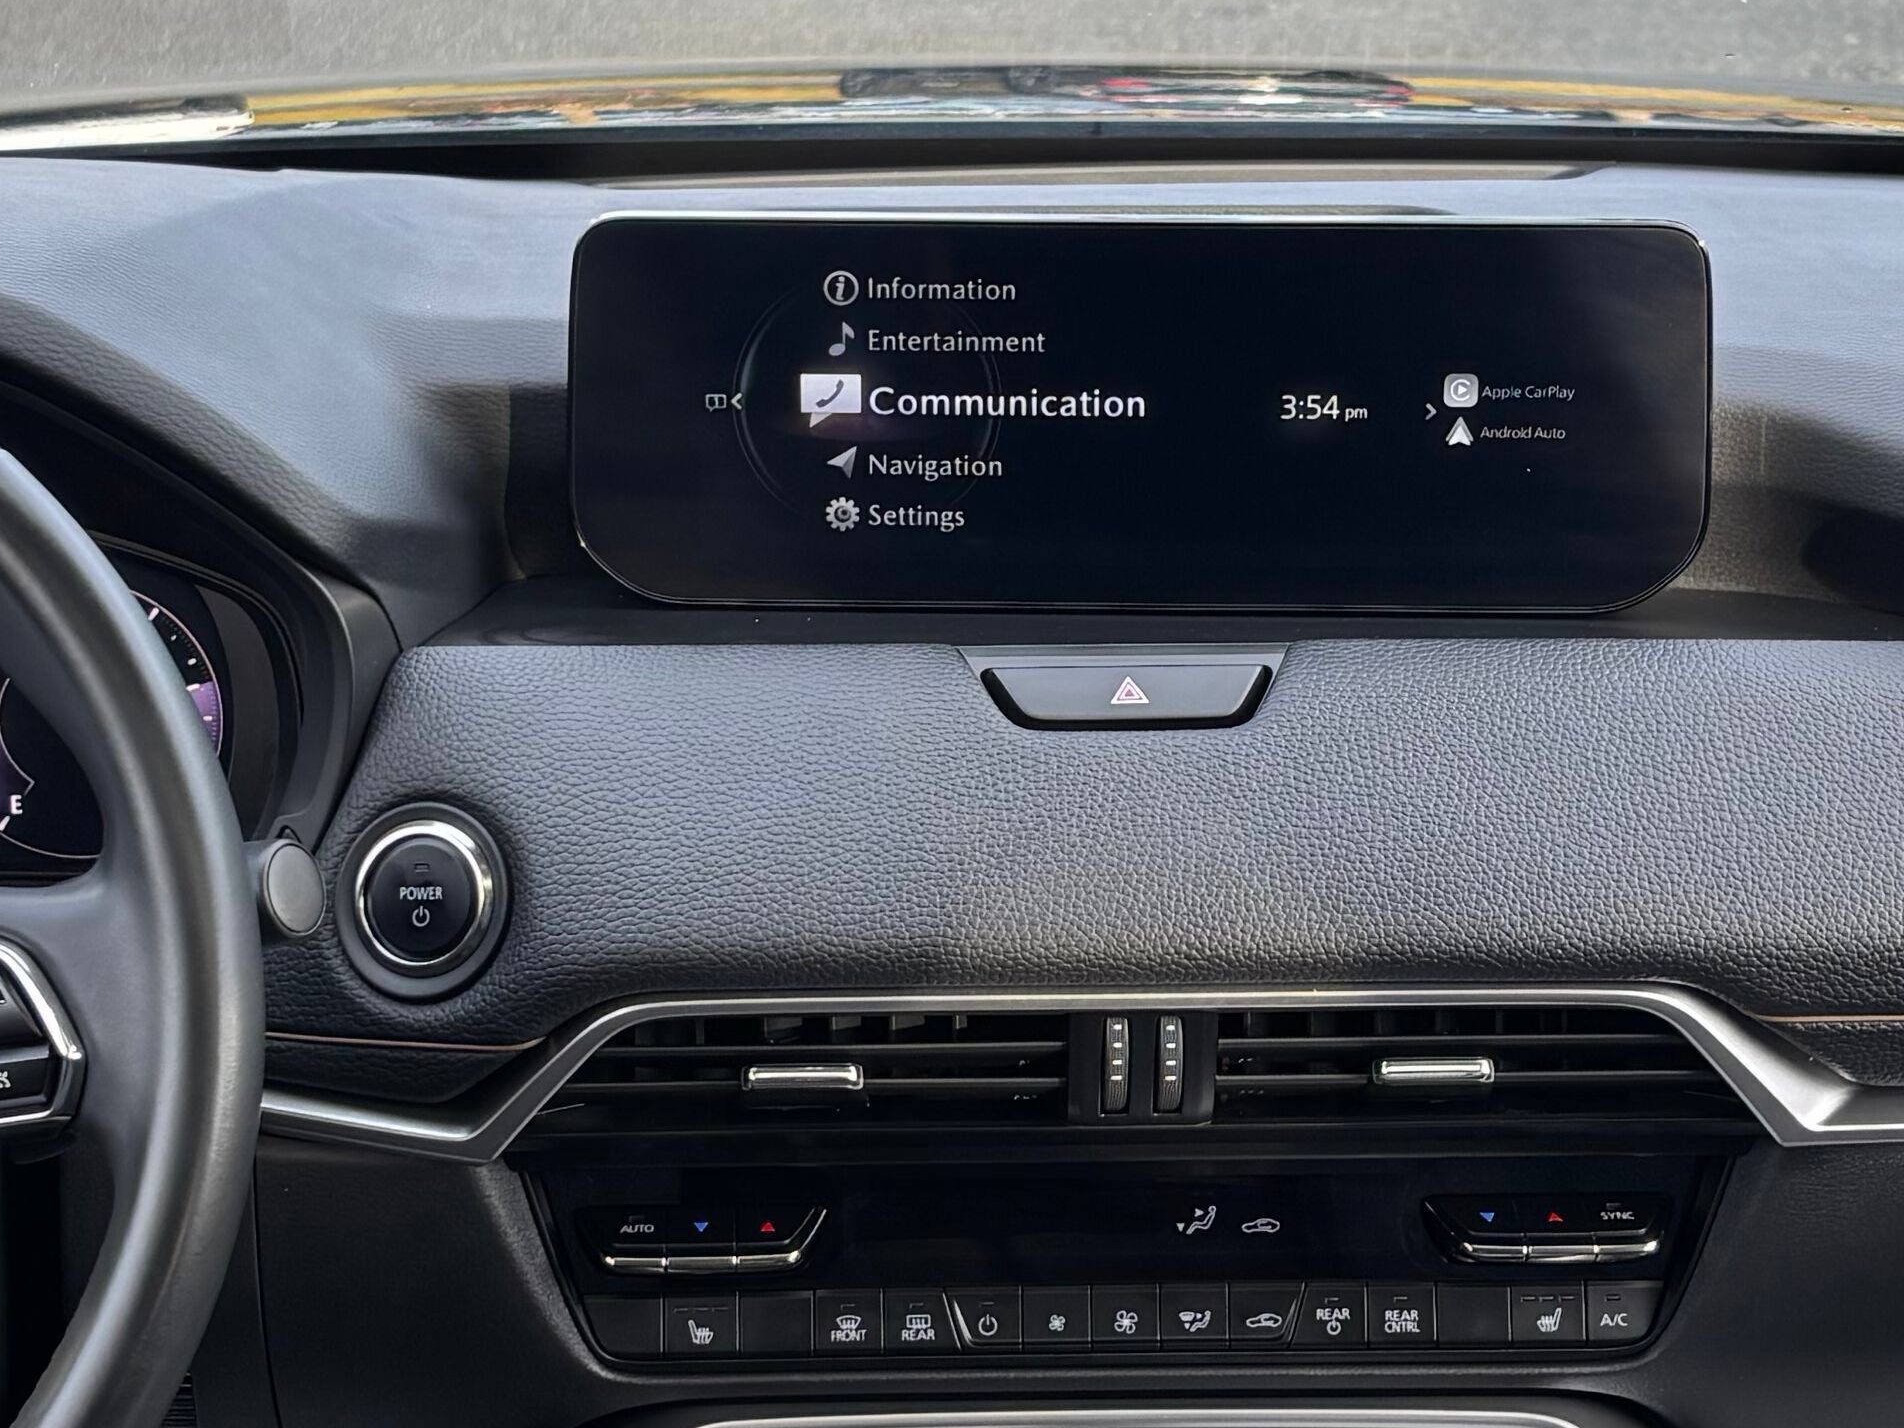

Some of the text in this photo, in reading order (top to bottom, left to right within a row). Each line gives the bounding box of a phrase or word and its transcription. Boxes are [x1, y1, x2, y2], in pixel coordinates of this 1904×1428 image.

[867, 275, 1016, 303] Information
[867, 328, 1046, 355] Entertainment
[1481, 383, 1576, 404] Apple CarPlay
[869, 385, 1146, 420] Communication
[1280, 394, 1369, 424] 3:54 pm
[1480, 424, 1567, 441] Android Auto
[868, 452, 1004, 483] Navigation
[868, 503, 966, 534] Settings
[10, 795, 23, 815] E
[399, 886, 443, 901] POWER
[1600, 1210, 1635, 1221] SYNC
[619, 1222, 655, 1234] AUTO
[1316, 1308, 1351, 1321] REAR
[1384, 1309, 1419, 1322] REAR
[1600, 1313, 1629, 1327] A/C
[901, 1327, 935, 1341] REAR
[1384, 1320, 1420, 1334] CNTRL
[830, 1328, 867, 1343] FRONT
